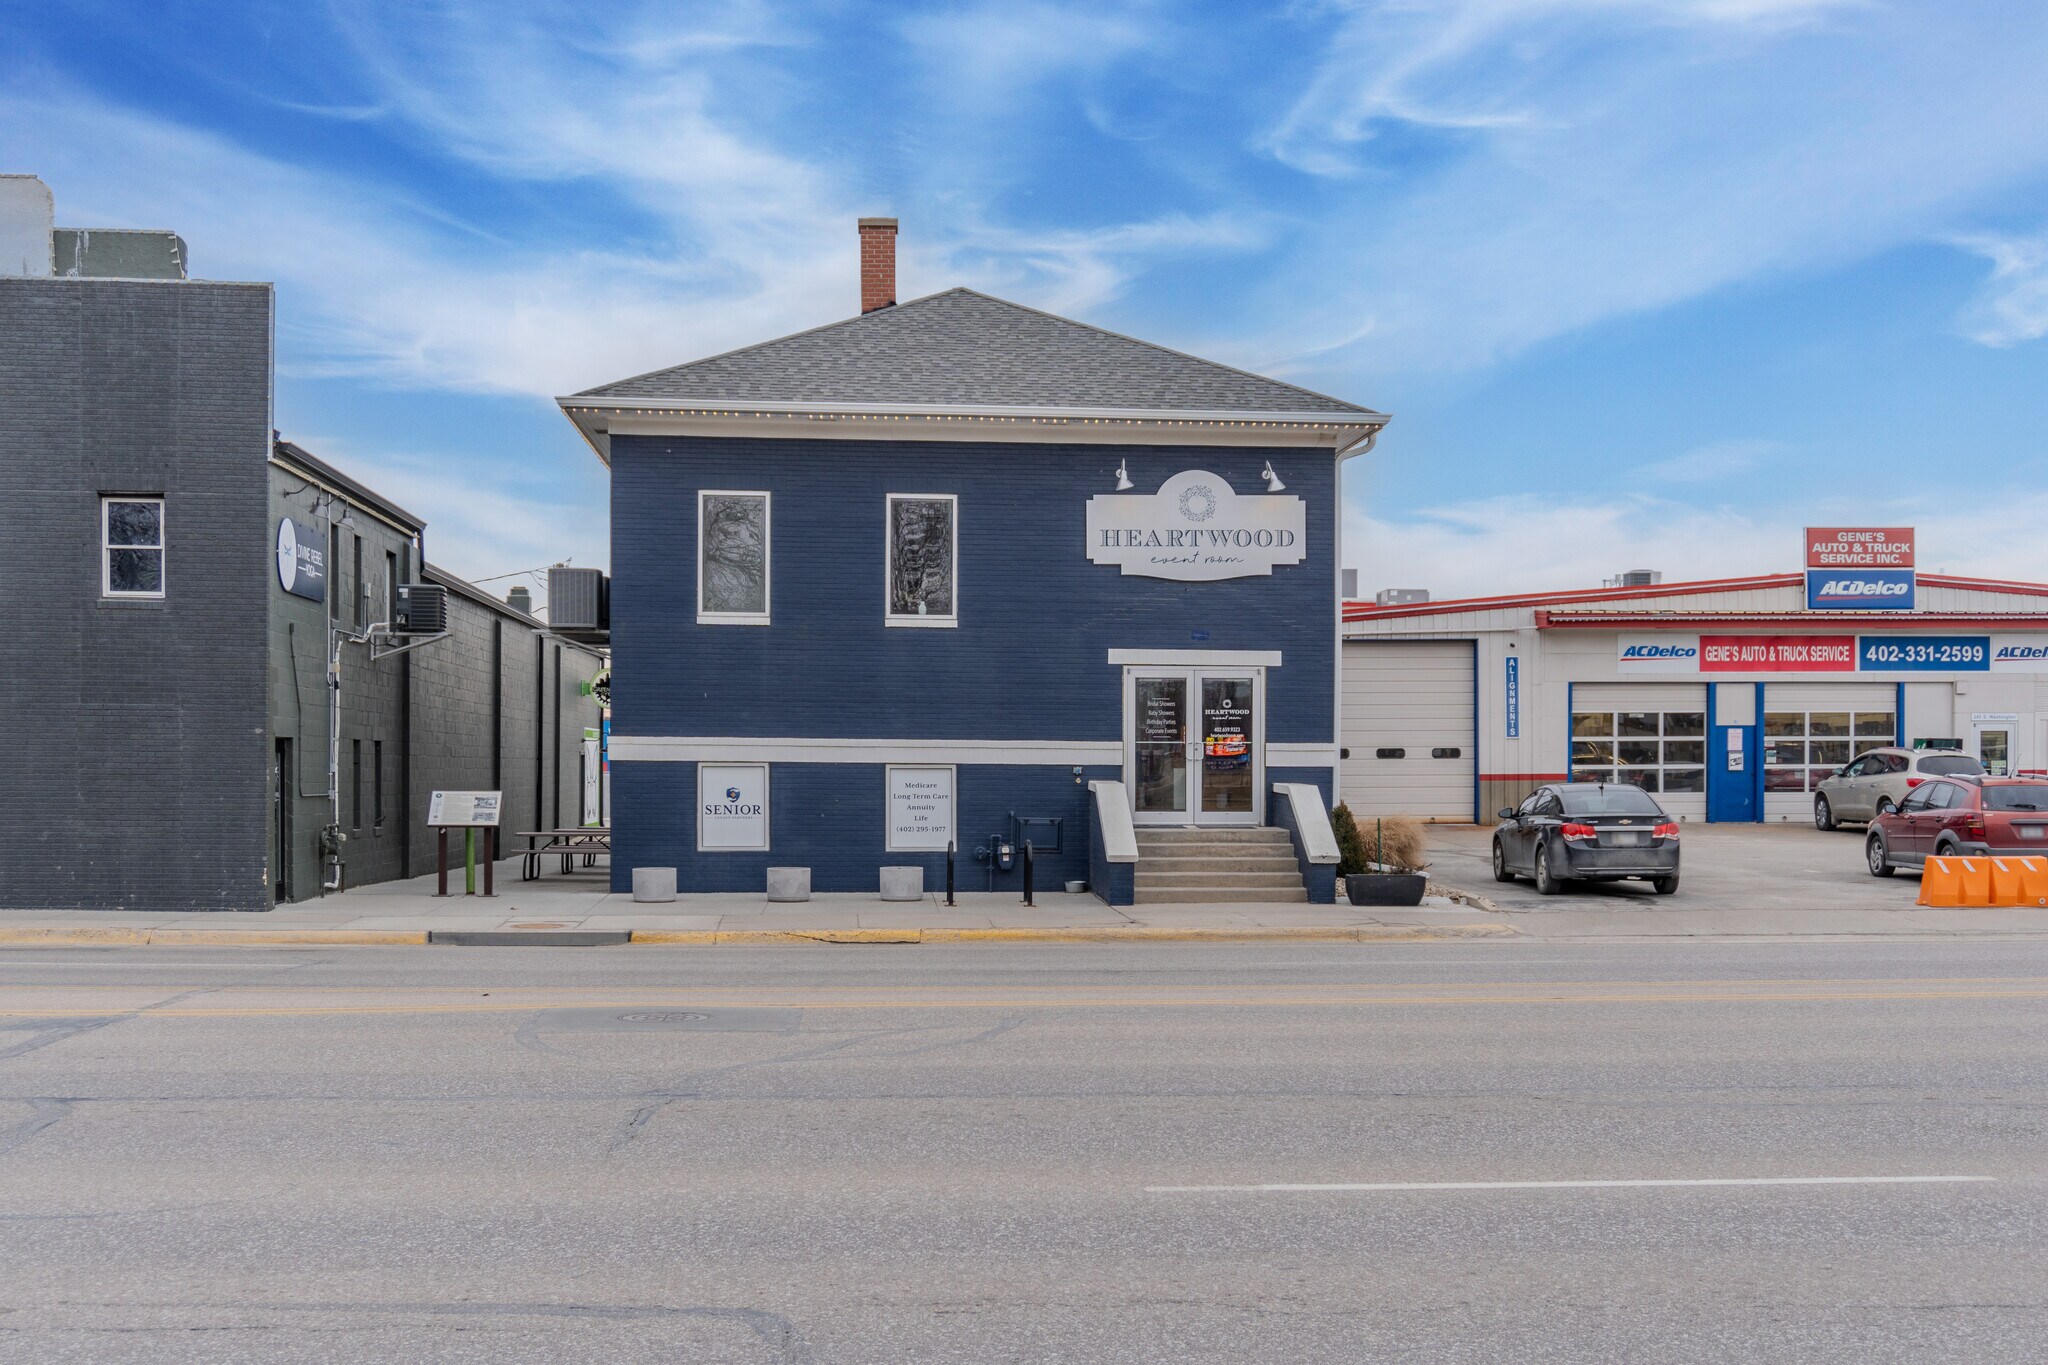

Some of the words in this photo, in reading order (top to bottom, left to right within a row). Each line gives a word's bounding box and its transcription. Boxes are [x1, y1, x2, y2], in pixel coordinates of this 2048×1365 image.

[1100, 529, 1294, 547] HEARTWOOD
[1837, 532, 1885, 542] GENE'S
[1812, 543, 1849, 552] AUTO
[1852, 543, 1863, 552] &
[1865, 543, 1910, 552] TRUCK
[311, 549, 323, 566] REBEL
[1151, 551, 1199, 564] event
[1205, 556, 1244, 564] room
[1820, 554, 1874, 563] SERVICE
[1877, 554, 1903, 563] INC.
[1820, 581, 1909, 595] ACDelco
[1623, 645, 1697, 657] ACDelco
[1705, 646, 1739, 662] GENE'S
[1740, 646, 1767, 662] AUTO
[1769, 646, 1776, 662] &
[1777, 646, 1809, 662] TRUCK
[1810, 646, 1850, 662] SERVICE
[1866, 645, 1983, 662] 402-331-2599
[1508, 659, 1516, 735] ALIGNMENTS
[705, 804, 762, 815] SENIOR
